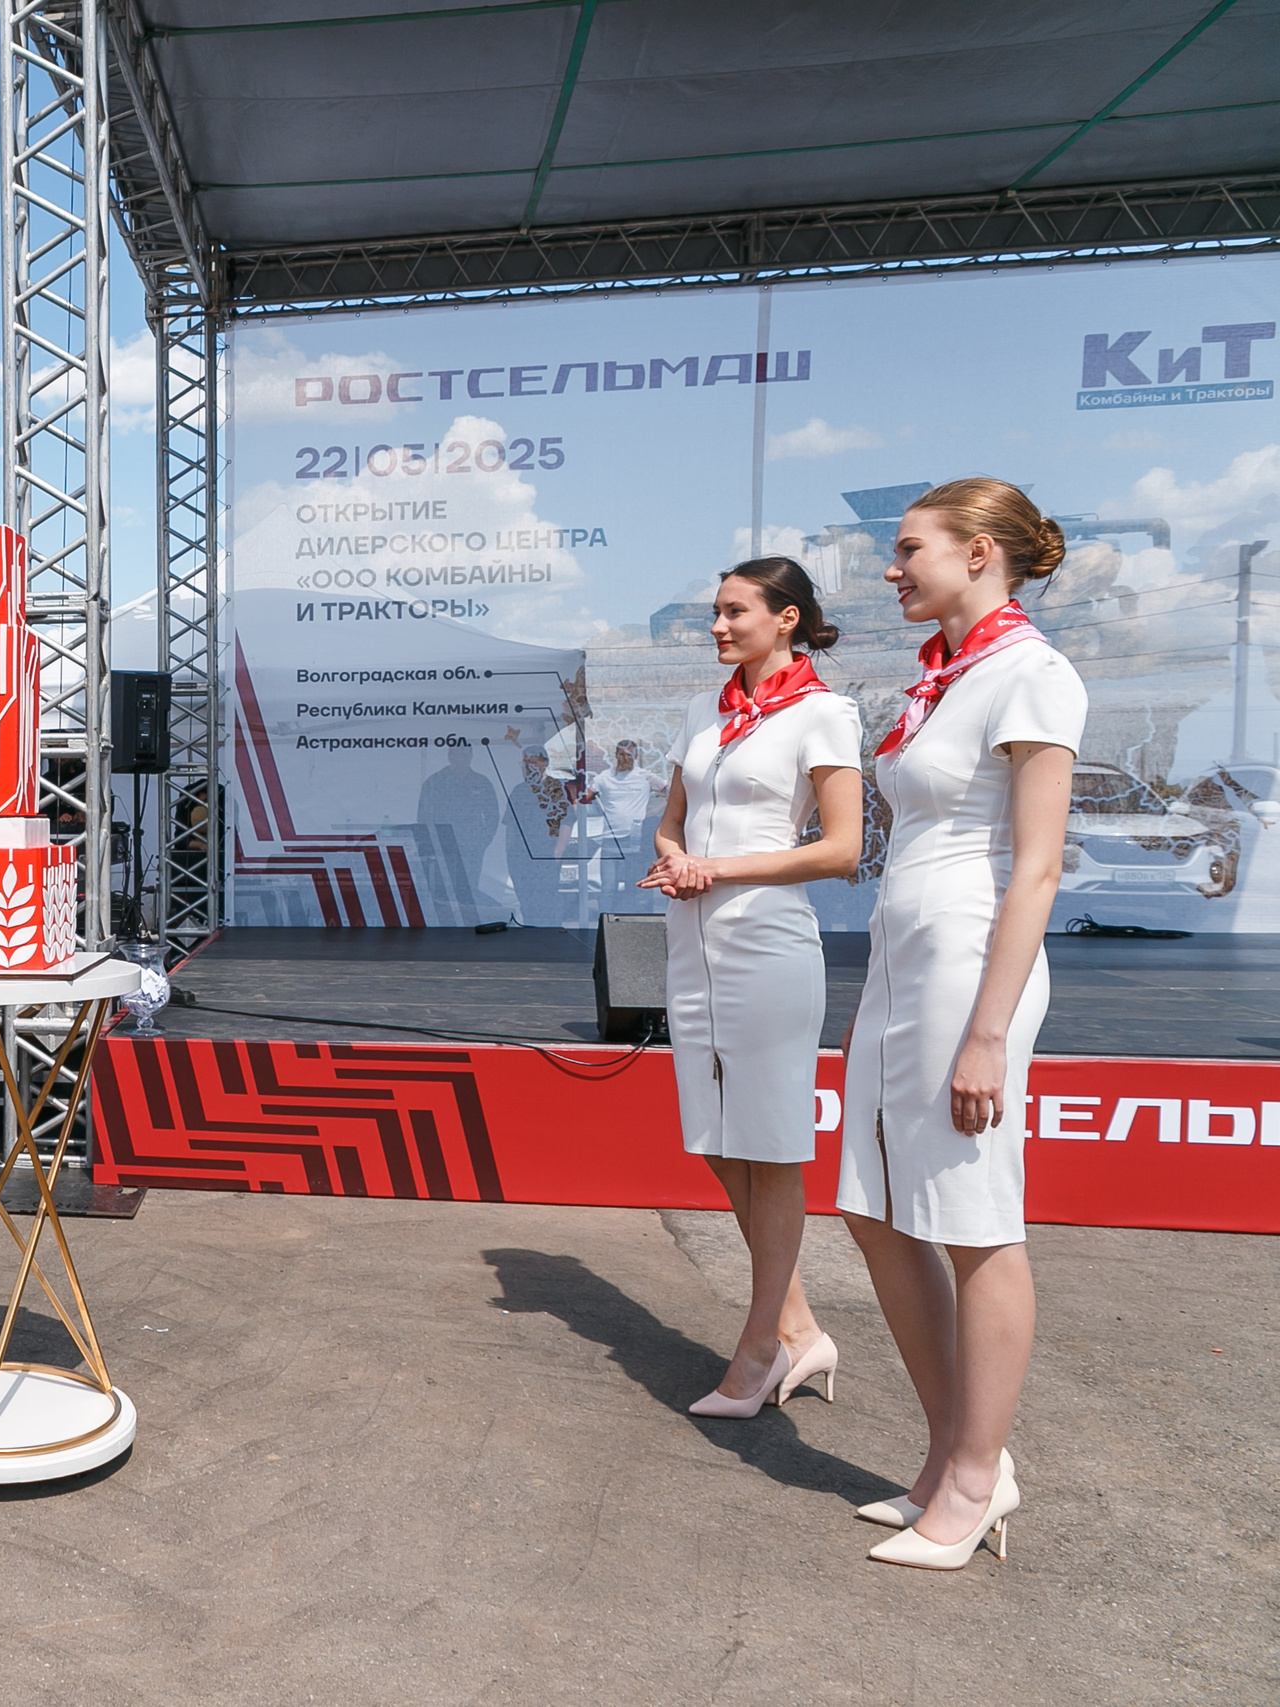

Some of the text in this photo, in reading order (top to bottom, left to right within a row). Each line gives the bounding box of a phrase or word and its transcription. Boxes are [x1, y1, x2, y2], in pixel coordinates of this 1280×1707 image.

[1081, 321, 1276, 388] КиТ
[294, 349, 812, 407] РОСТСЕЛЬМАШ
[1079, 386, 1270, 406] Комбайны и Тракторы
[296, 500, 448, 524] ОТКРЫТИЕ
[295, 527, 608, 559] ДИЛЕРСКОГО ЦЕНТРА
[296, 559, 552, 589] «ООО КОМБАЙНЫ
[296, 598, 490, 622] И ТРАКТОРЫ»
[296, 666, 481, 684] Волгоградская обл.
[296, 701, 509, 719] Республика Калмыкия
[296, 734, 472, 752] Астраханская обл.
